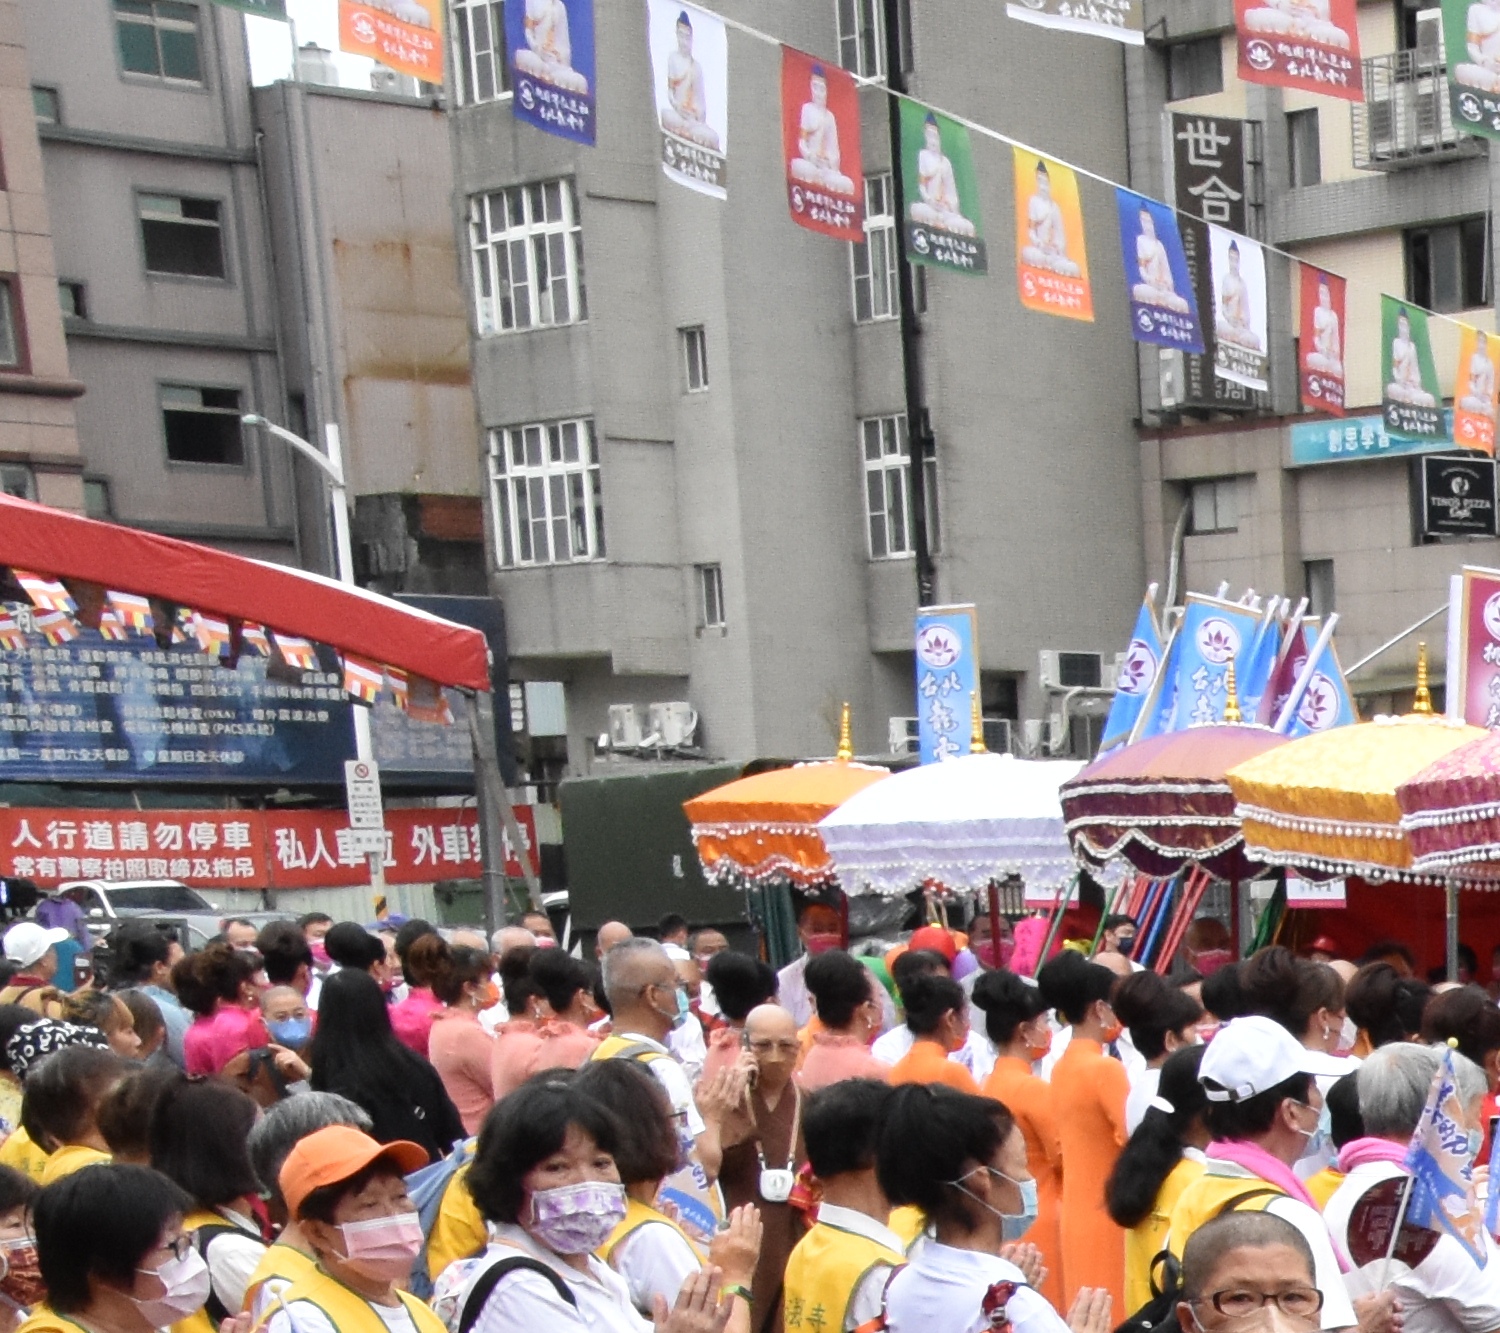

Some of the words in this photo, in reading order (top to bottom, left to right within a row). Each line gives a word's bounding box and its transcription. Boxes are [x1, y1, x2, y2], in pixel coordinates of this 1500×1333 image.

[12, 819, 251, 850] 人行道請勿停車
[13, 856, 254, 878] 常有警察拍照取締及拖吊
